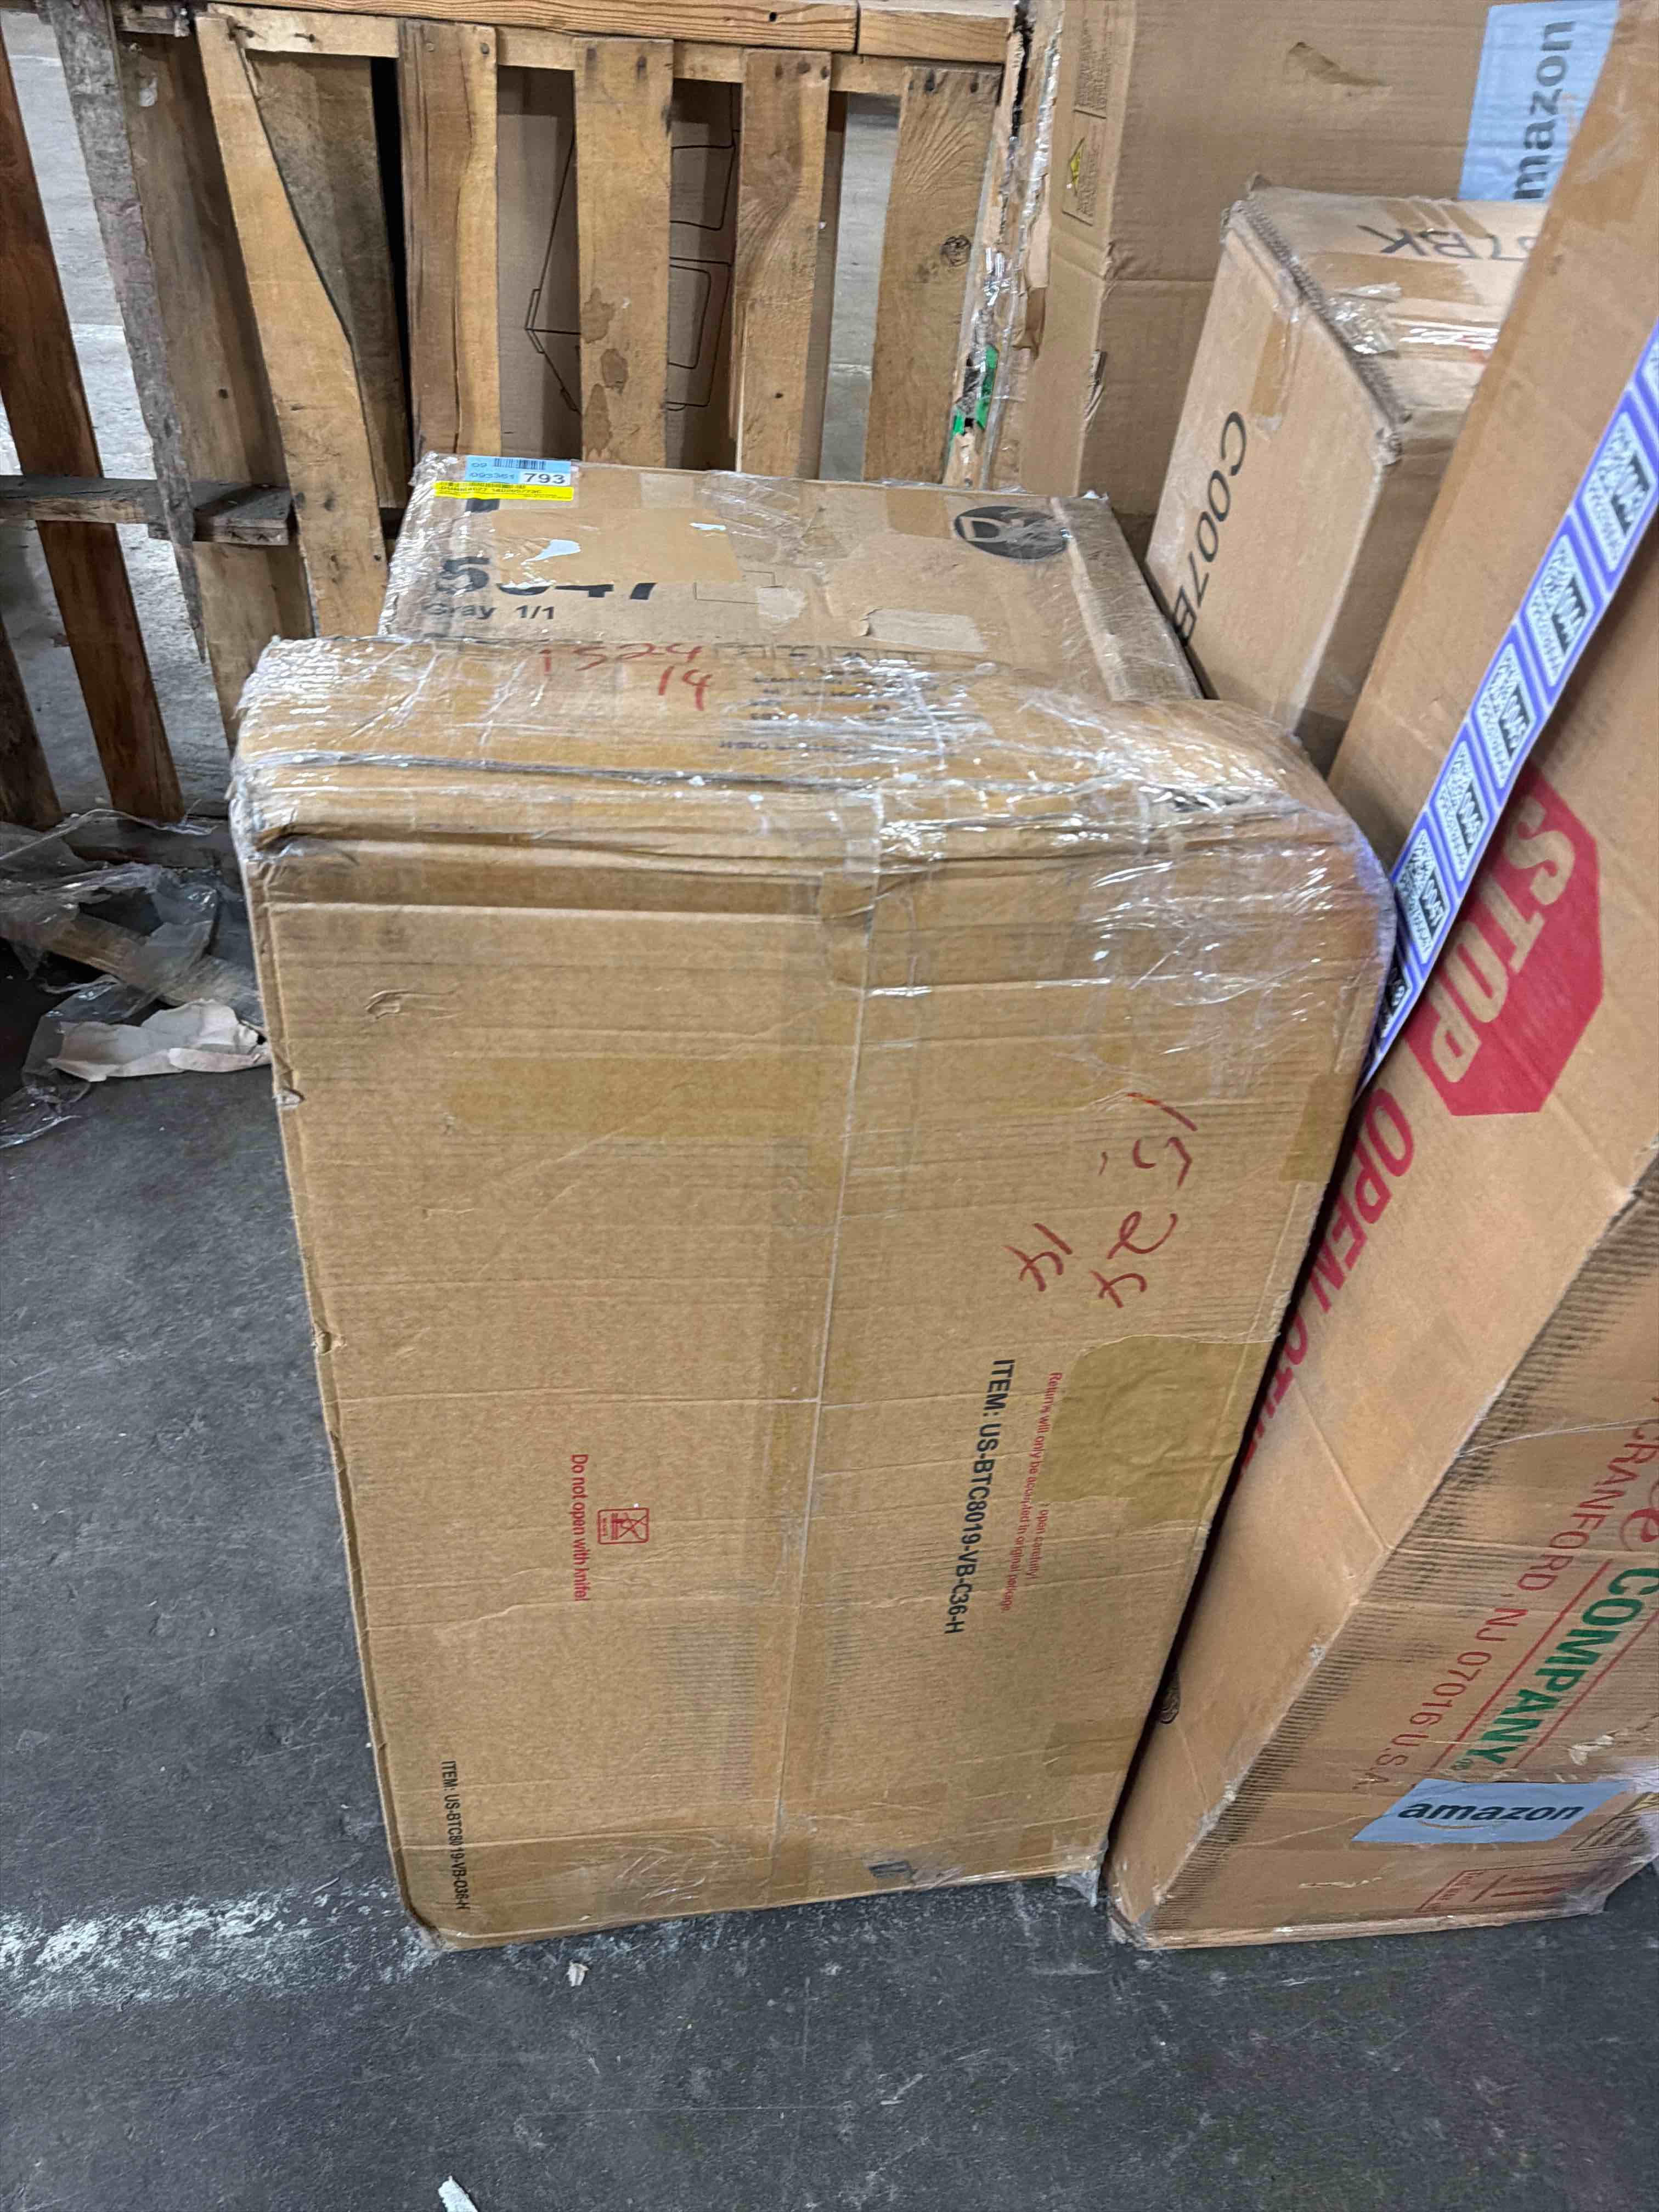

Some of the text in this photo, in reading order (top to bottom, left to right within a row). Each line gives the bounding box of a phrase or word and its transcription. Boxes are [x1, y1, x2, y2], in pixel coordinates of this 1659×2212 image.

[1513, 21, 1576, 199] mazon
[523, 472, 566, 484] 793
[516, 605, 555, 620] 1/1
[658, 665, 713, 712] 14
[1430, 793, 1576, 1084] STOP
[1310, 1088, 1414, 1313] OPEN
[1003, 1223, 1073, 1291] 14
[1040, 1372, 1063, 1414] Returns
[1036, 1415, 1050, 1434] will
[1029, 1436, 1045, 1459] only
[1029, 1460, 1041, 1475] be
[944, 1359, 1015, 1634] ITEM: US-BTC8019-VB-C36-H
[569, 1454, 591, 1601] Do not open with knife!
[1035, 1509, 1049, 1534] open
[1008, 1536, 1026, 1573] original
[1475, 1608, 1528, 1642] NJ
[1467, 1567, 1659, 1764] COMPANY
[1409, 1651, 1492, 1726] 07016
[441, 1759, 459, 1791] ITEM:
[1397, 1802, 1585, 1822] amazon
